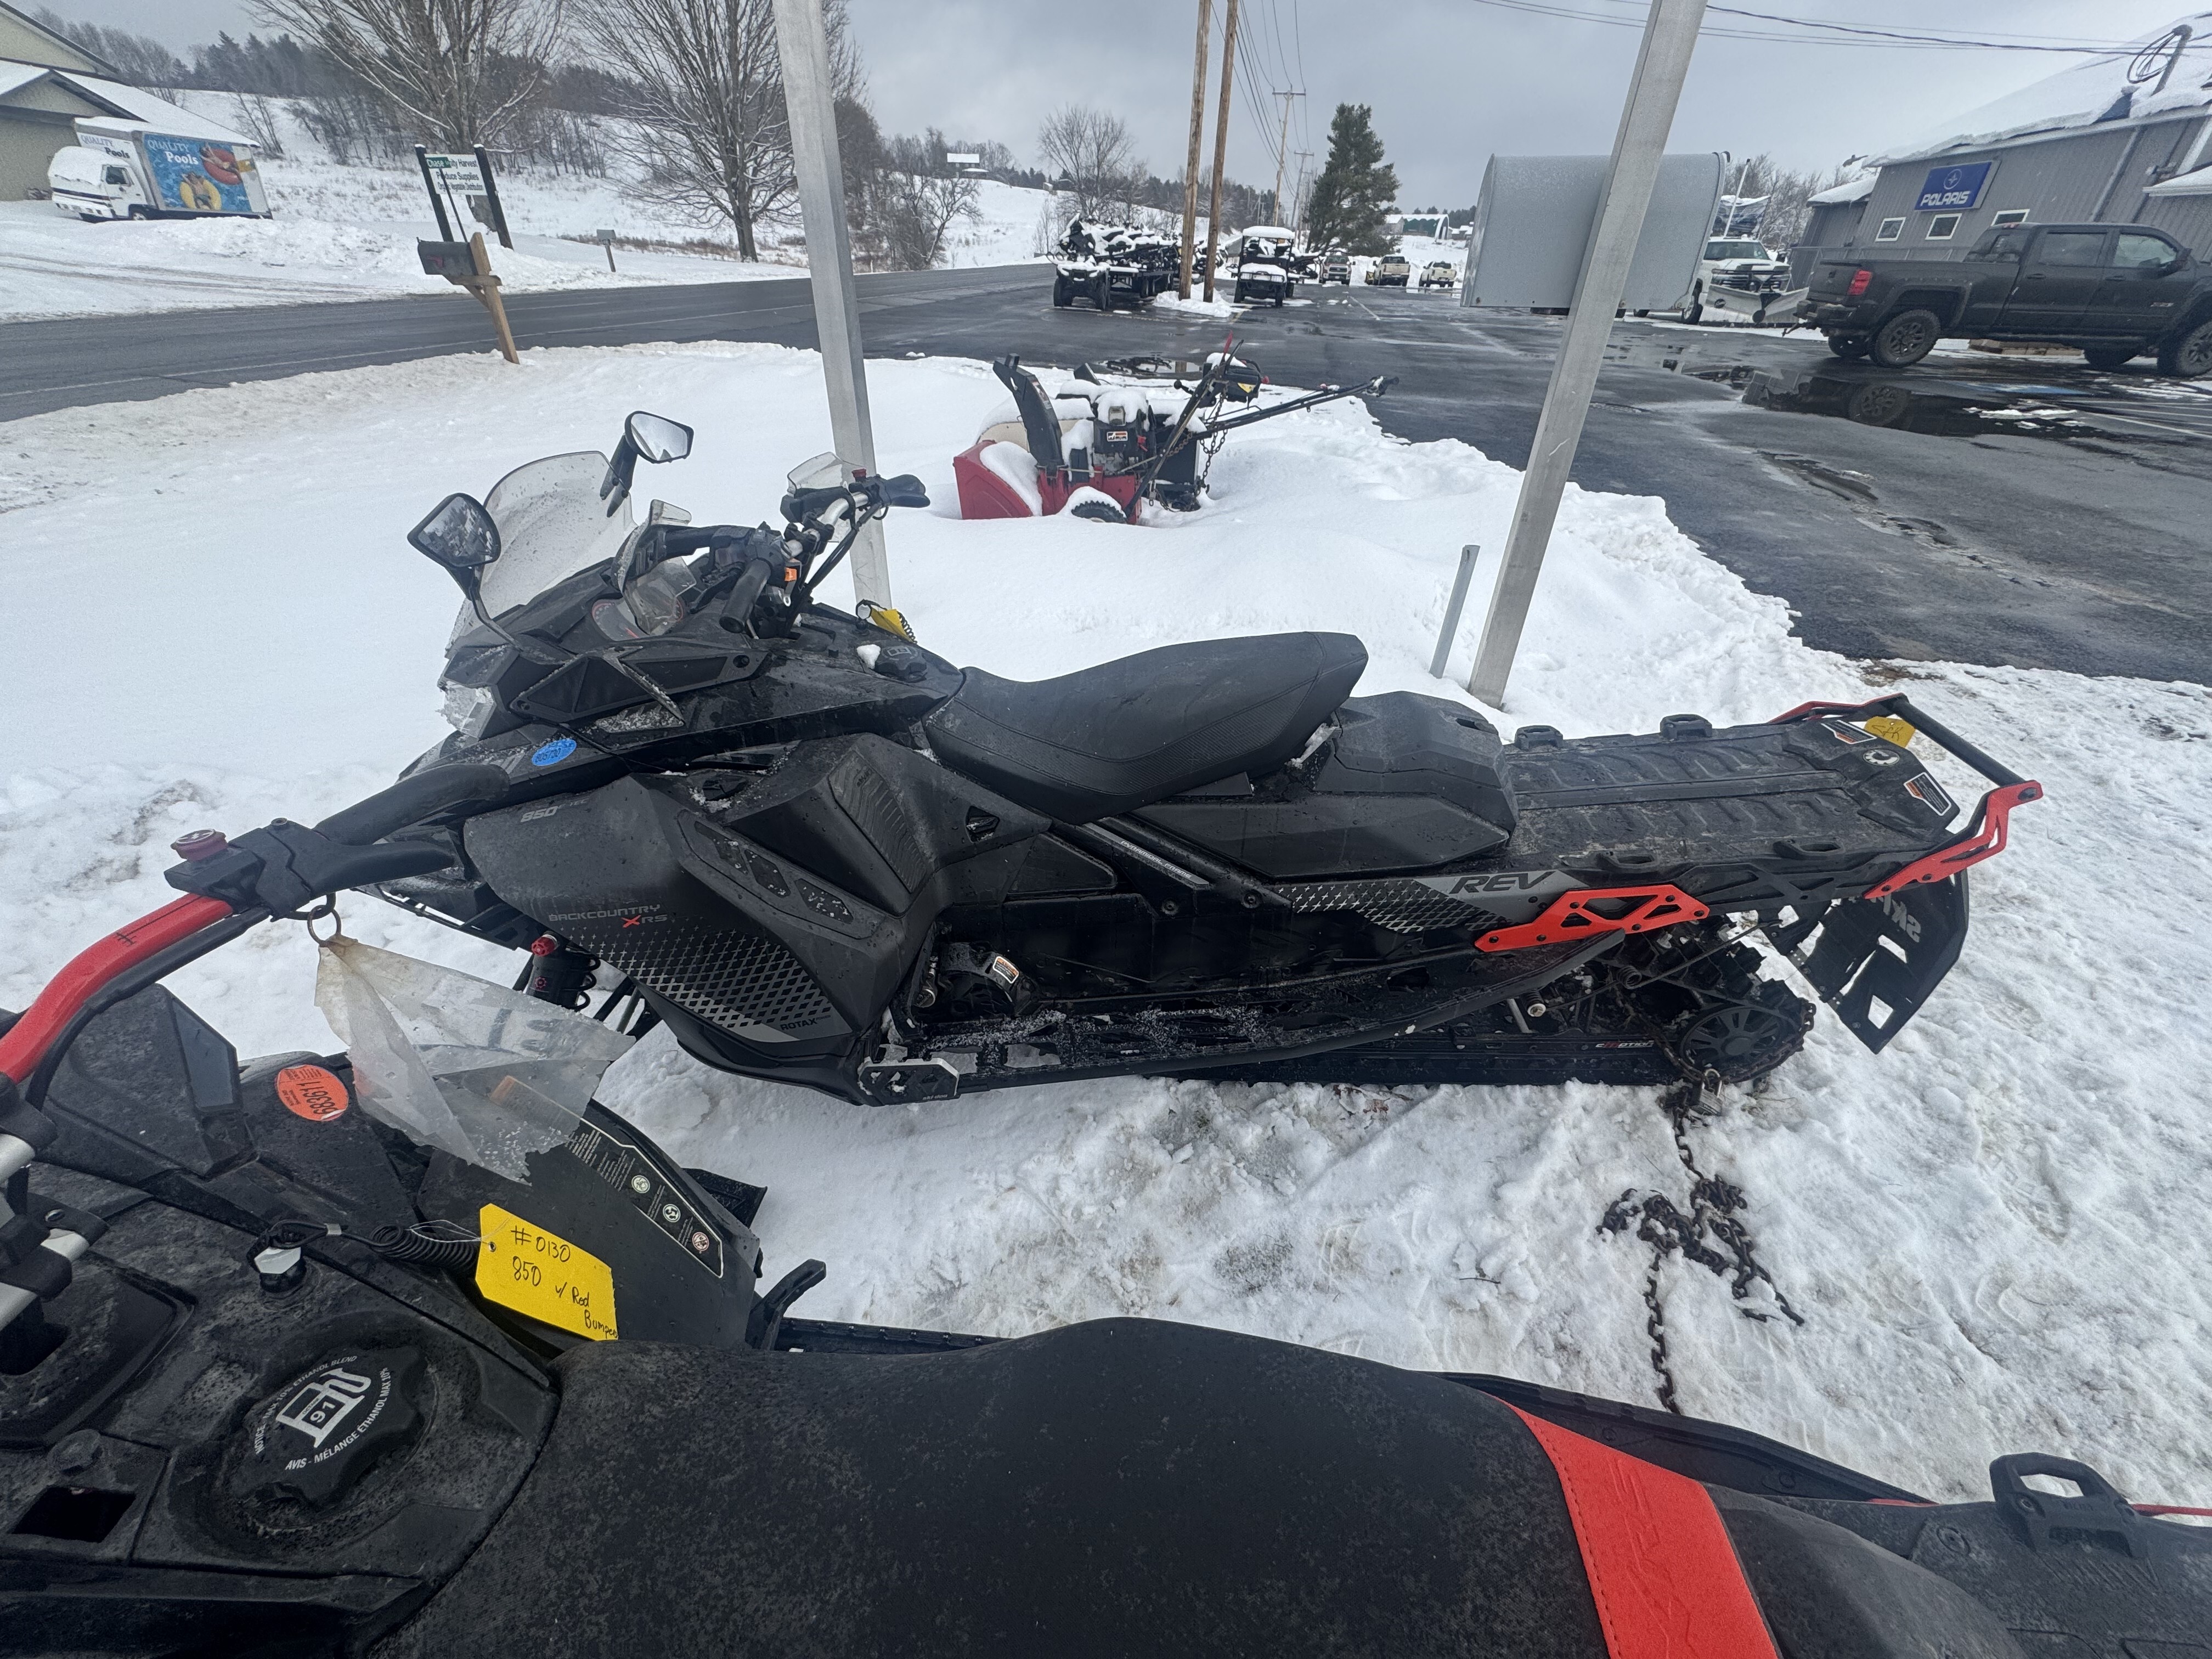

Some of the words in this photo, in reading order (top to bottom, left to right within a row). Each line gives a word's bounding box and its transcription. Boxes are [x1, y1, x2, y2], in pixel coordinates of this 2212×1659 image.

[104, 146, 131, 159] Pools
[148, 139, 189, 152] QUALITY
[165, 151, 199, 165] Pools
[1920, 190, 1971, 206] POLARIS
[521, 806, 558, 822] 850
[1120, 840, 1163, 865] PYRAMIDAL
[1164, 862, 1193, 879] FRAME
[1449, 871, 1556, 894] REV
[549, 904, 661, 922] BACKCOUNTRY
[621, 914, 668, 928] XRS
[780, 1018, 817, 1031] ROTAX
[513, 1256, 541, 1286] 850
[293, 1363, 329, 1386] ETHANOL
[330, 1356, 357, 1366] BLEND
[309, 1401, 336, 1423] 91
[285, 1457, 308, 1470] AVIS
[314, 1430, 360, 1464] MÉLANGE
[357, 1397, 387, 1433] ÉTHANOL
[380, 1380, 391, 1397] MAX
